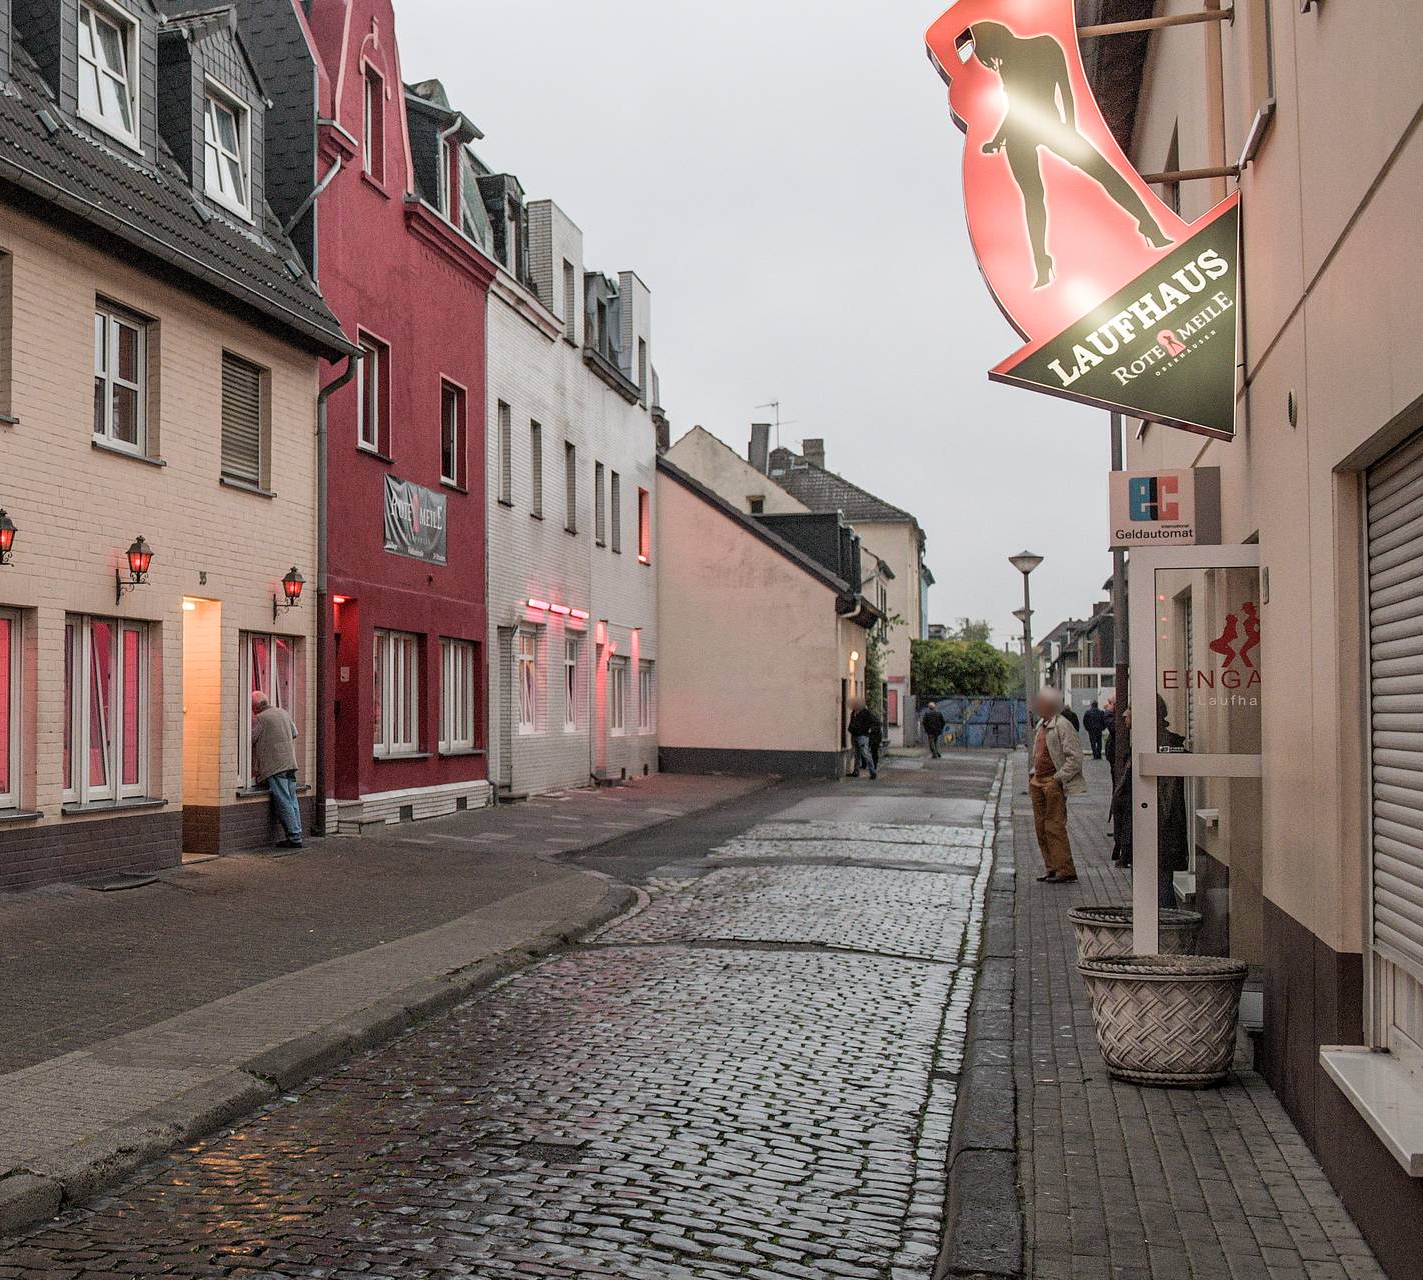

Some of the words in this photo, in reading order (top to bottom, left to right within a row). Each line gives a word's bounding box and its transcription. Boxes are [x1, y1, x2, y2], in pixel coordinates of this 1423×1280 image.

[1047, 249, 1229, 387] LAUFHAUS
[1111, 345, 1166, 386] ROTE
[1176, 291, 1233, 341] MEILE
[1155, 330, 1216, 376] OBERHAUSEN
[419, 505, 443, 530] MEILE
[1115, 529, 1194, 540] Geldautomat
